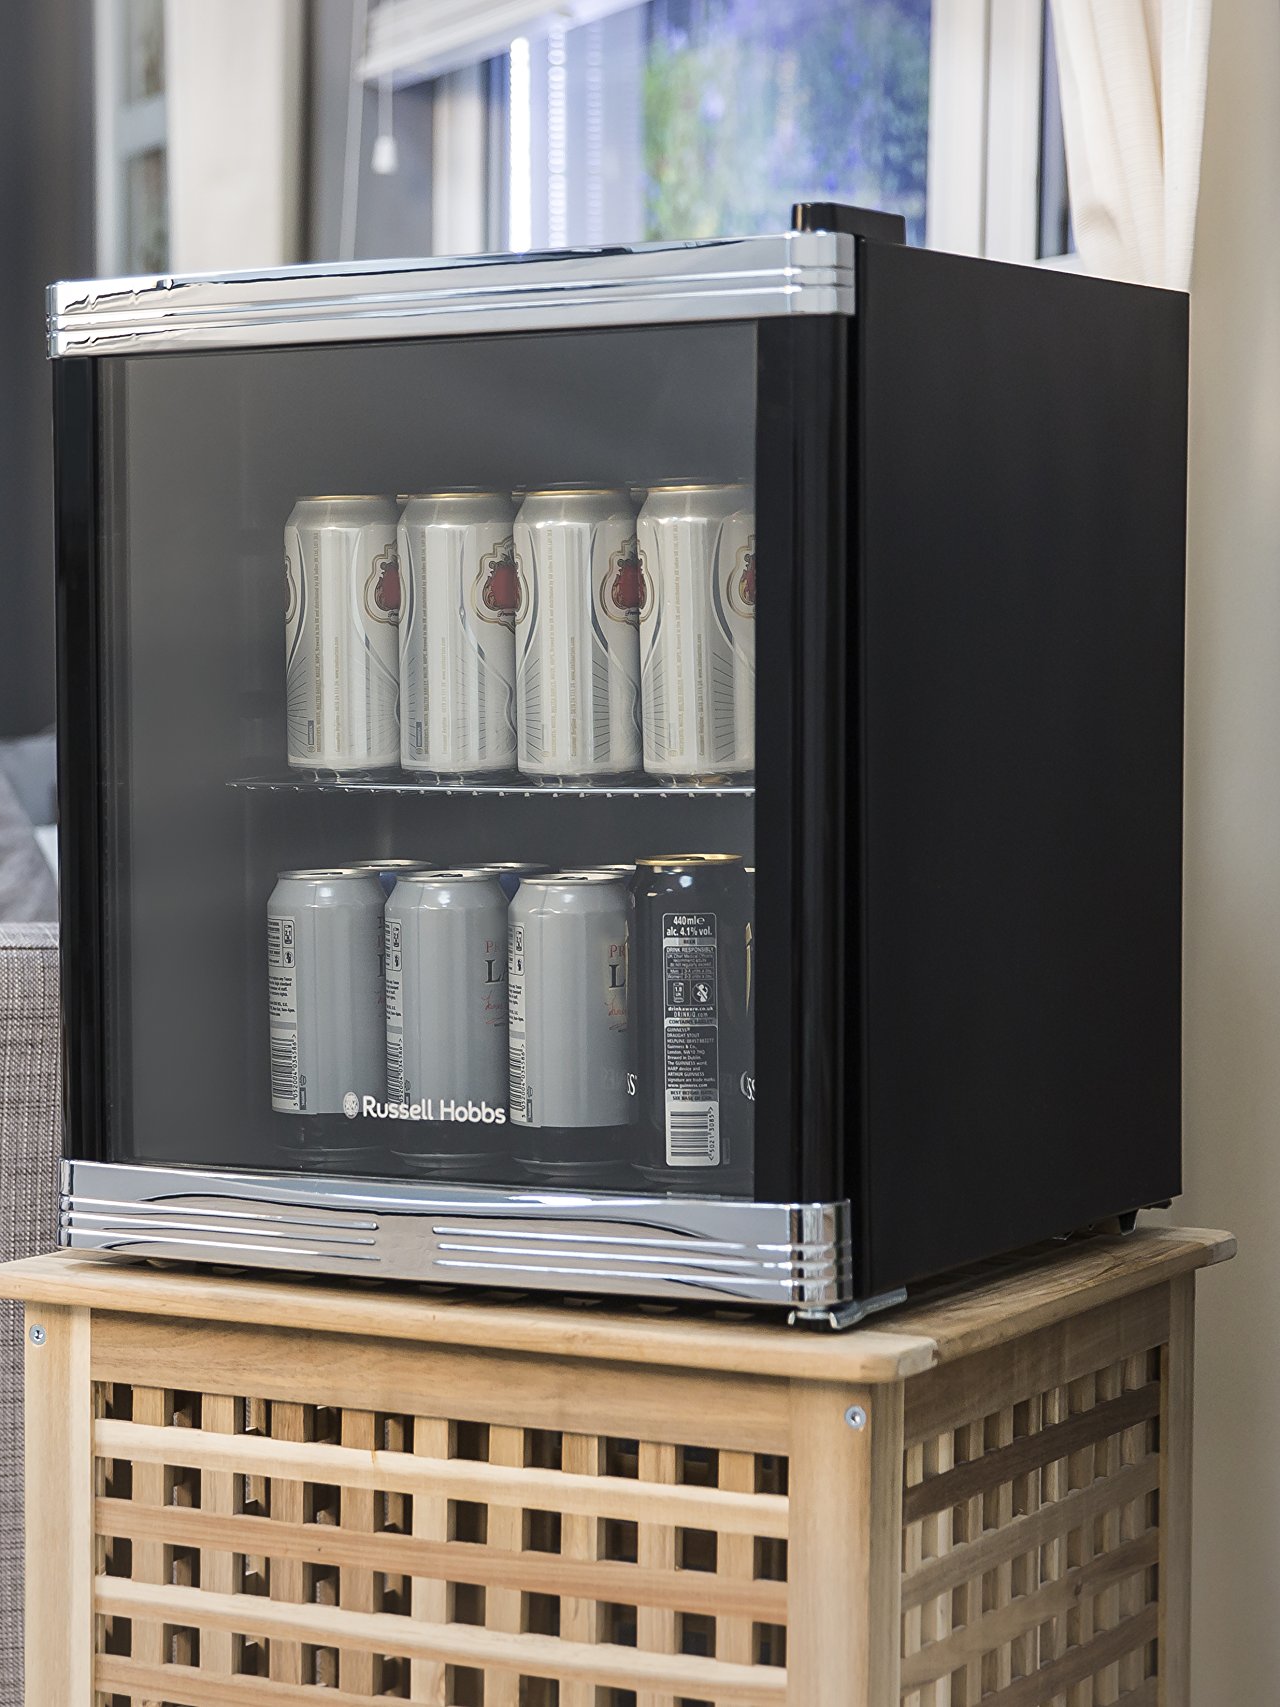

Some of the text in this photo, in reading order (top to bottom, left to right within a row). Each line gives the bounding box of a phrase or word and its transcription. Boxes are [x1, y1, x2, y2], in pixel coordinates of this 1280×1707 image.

[666, 926, 713, 936] alc. 4.1% vol.
[362, 1095, 434, 1121] Russell
[440, 1099, 507, 1124] Hobbs
